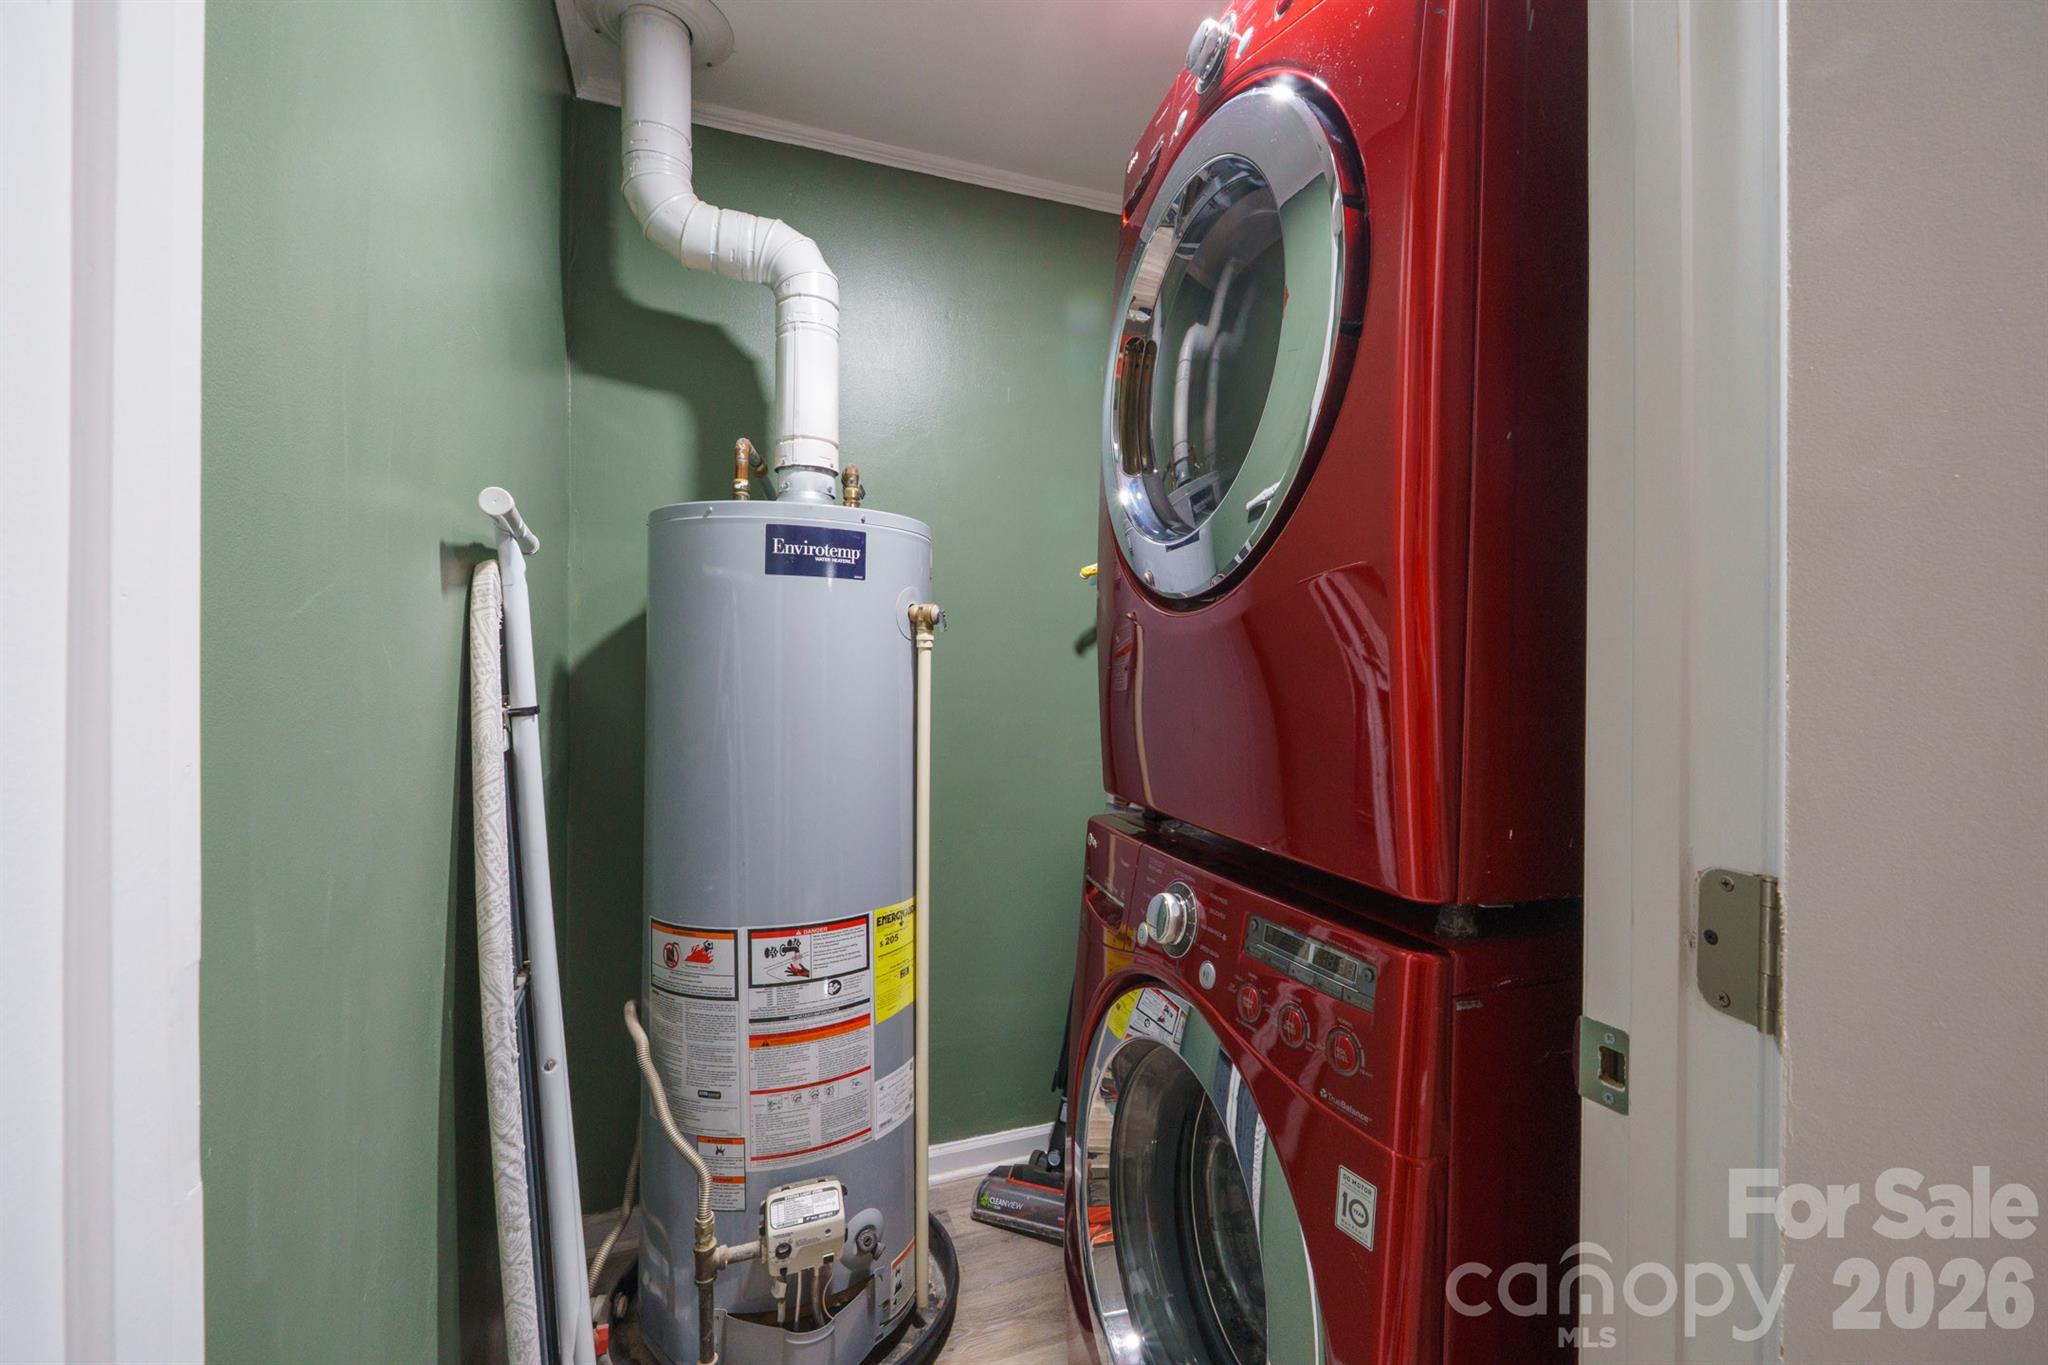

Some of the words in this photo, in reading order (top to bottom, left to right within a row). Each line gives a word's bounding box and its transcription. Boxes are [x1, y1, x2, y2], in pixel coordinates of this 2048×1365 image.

[772, 537, 861, 565] Envirotemp
[803, 926, 829, 935] DANGER
[885, 933, 899, 946] 205
[989, 1196, 1024, 1210] CLEANVIEW
[1342, 1191, 1370, 1229] 10
